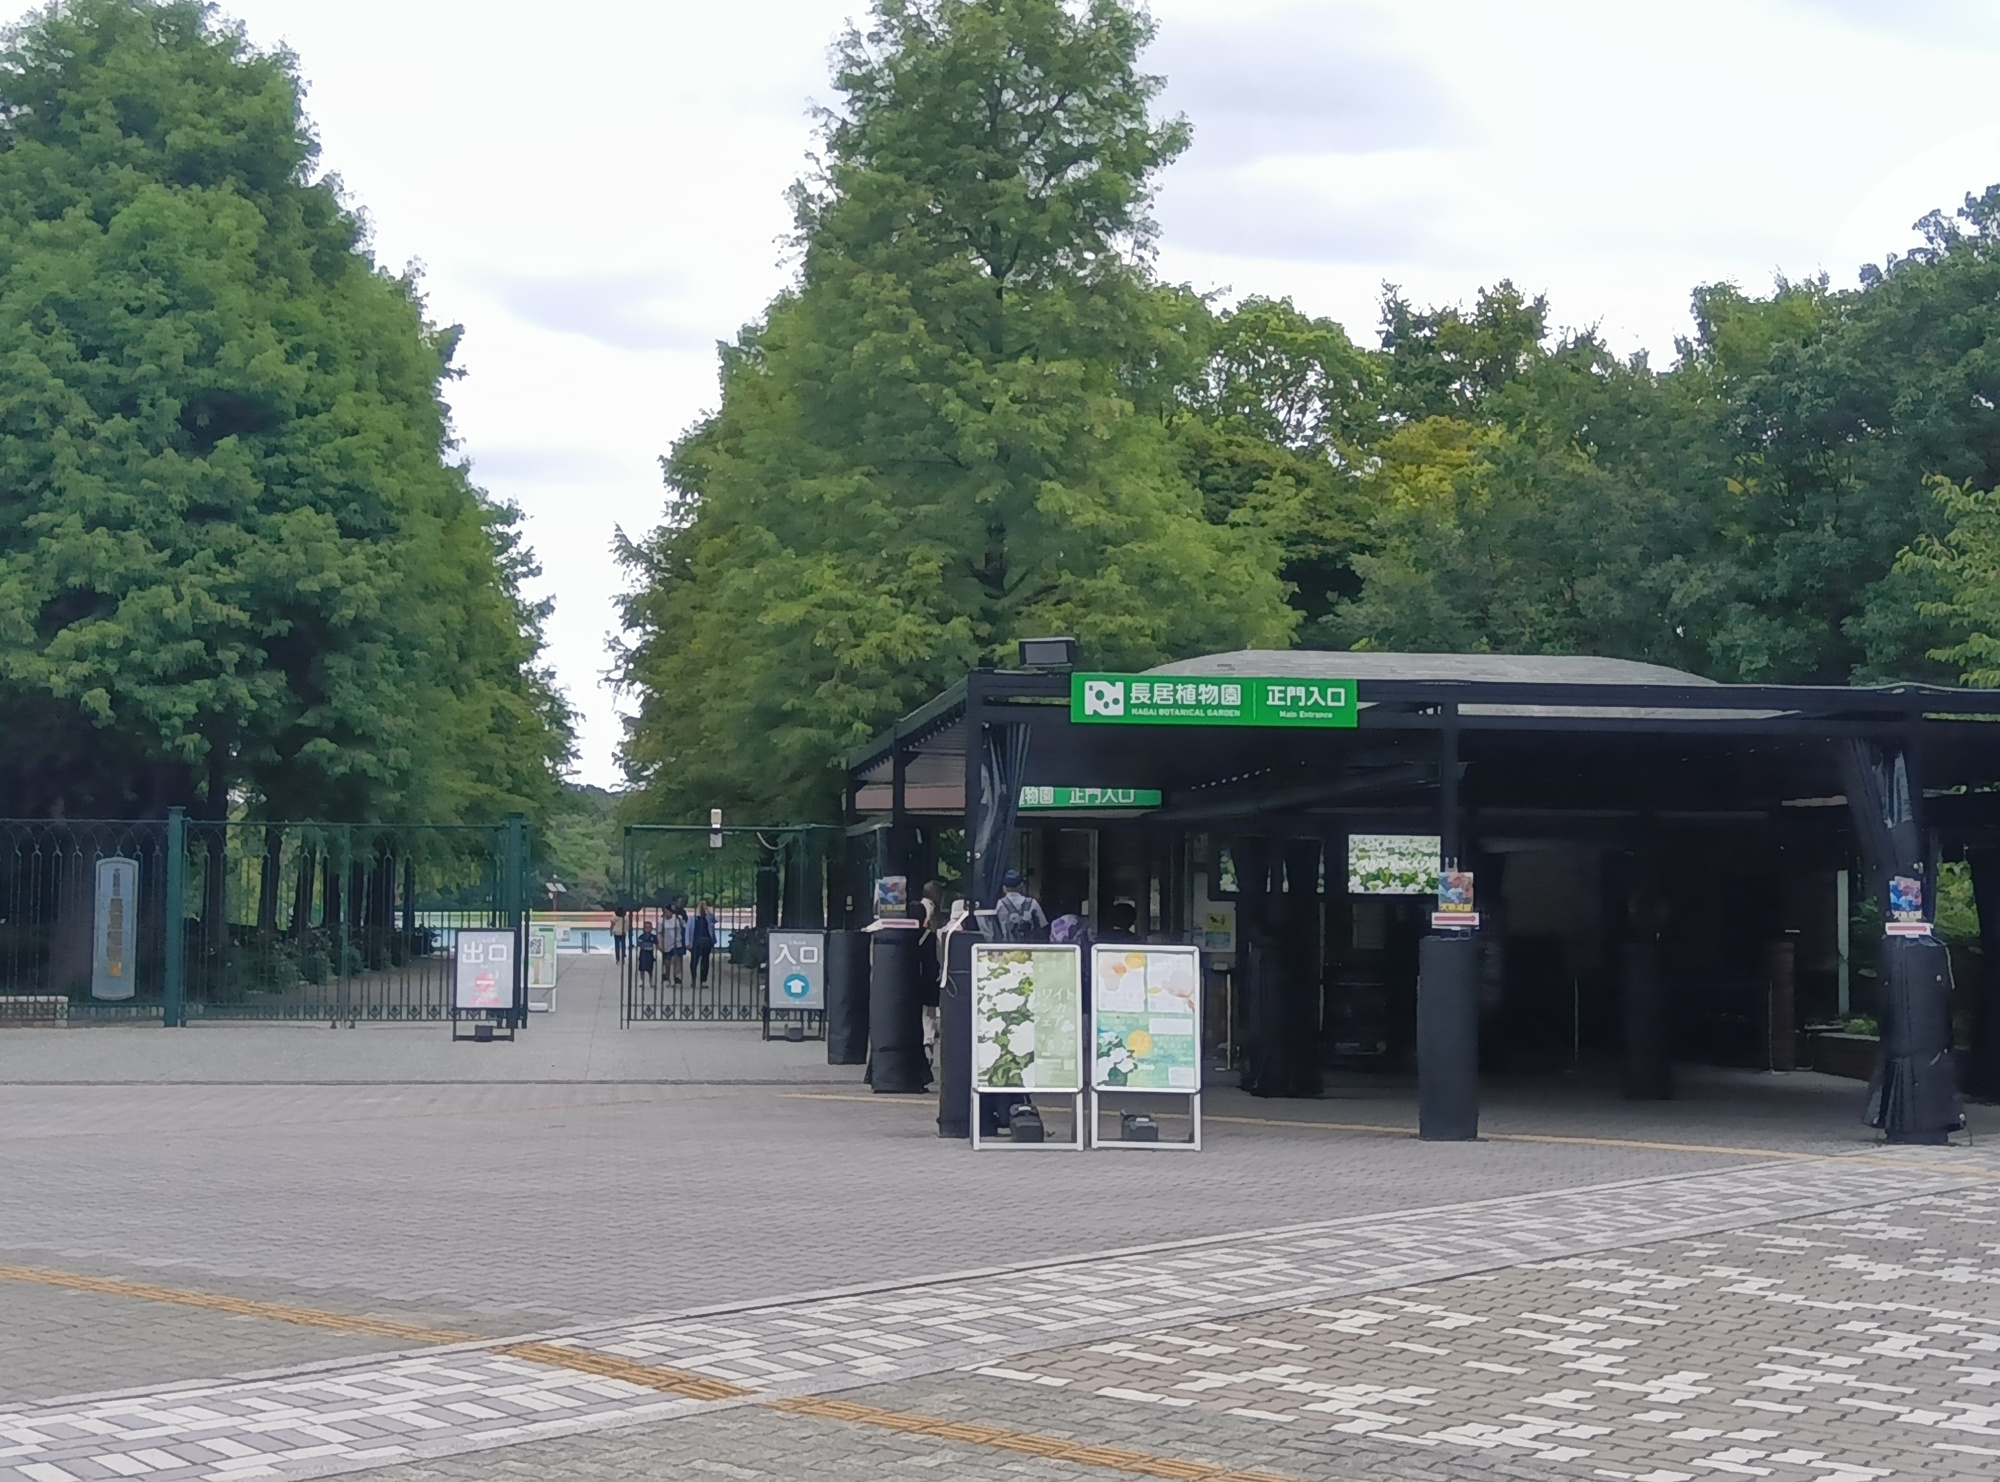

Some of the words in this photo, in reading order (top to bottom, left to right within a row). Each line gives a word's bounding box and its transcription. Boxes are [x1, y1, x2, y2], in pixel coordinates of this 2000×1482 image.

[1129, 682, 1241, 706] 長居植物園
[1266, 685, 1345, 707] 正門入口
[1131, 707, 1157, 716] NAGAI
[1158, 708, 1205, 717] BOTANICAL
[1207, 709, 1241, 717] GARDEN
[1279, 710, 1297, 718] Main
[1299, 710, 1333, 719] Entrance
[1069, 787, 1135, 804] 正門入口
[462, 941, 507, 963] 出口
[774, 943, 818, 965] 入口
